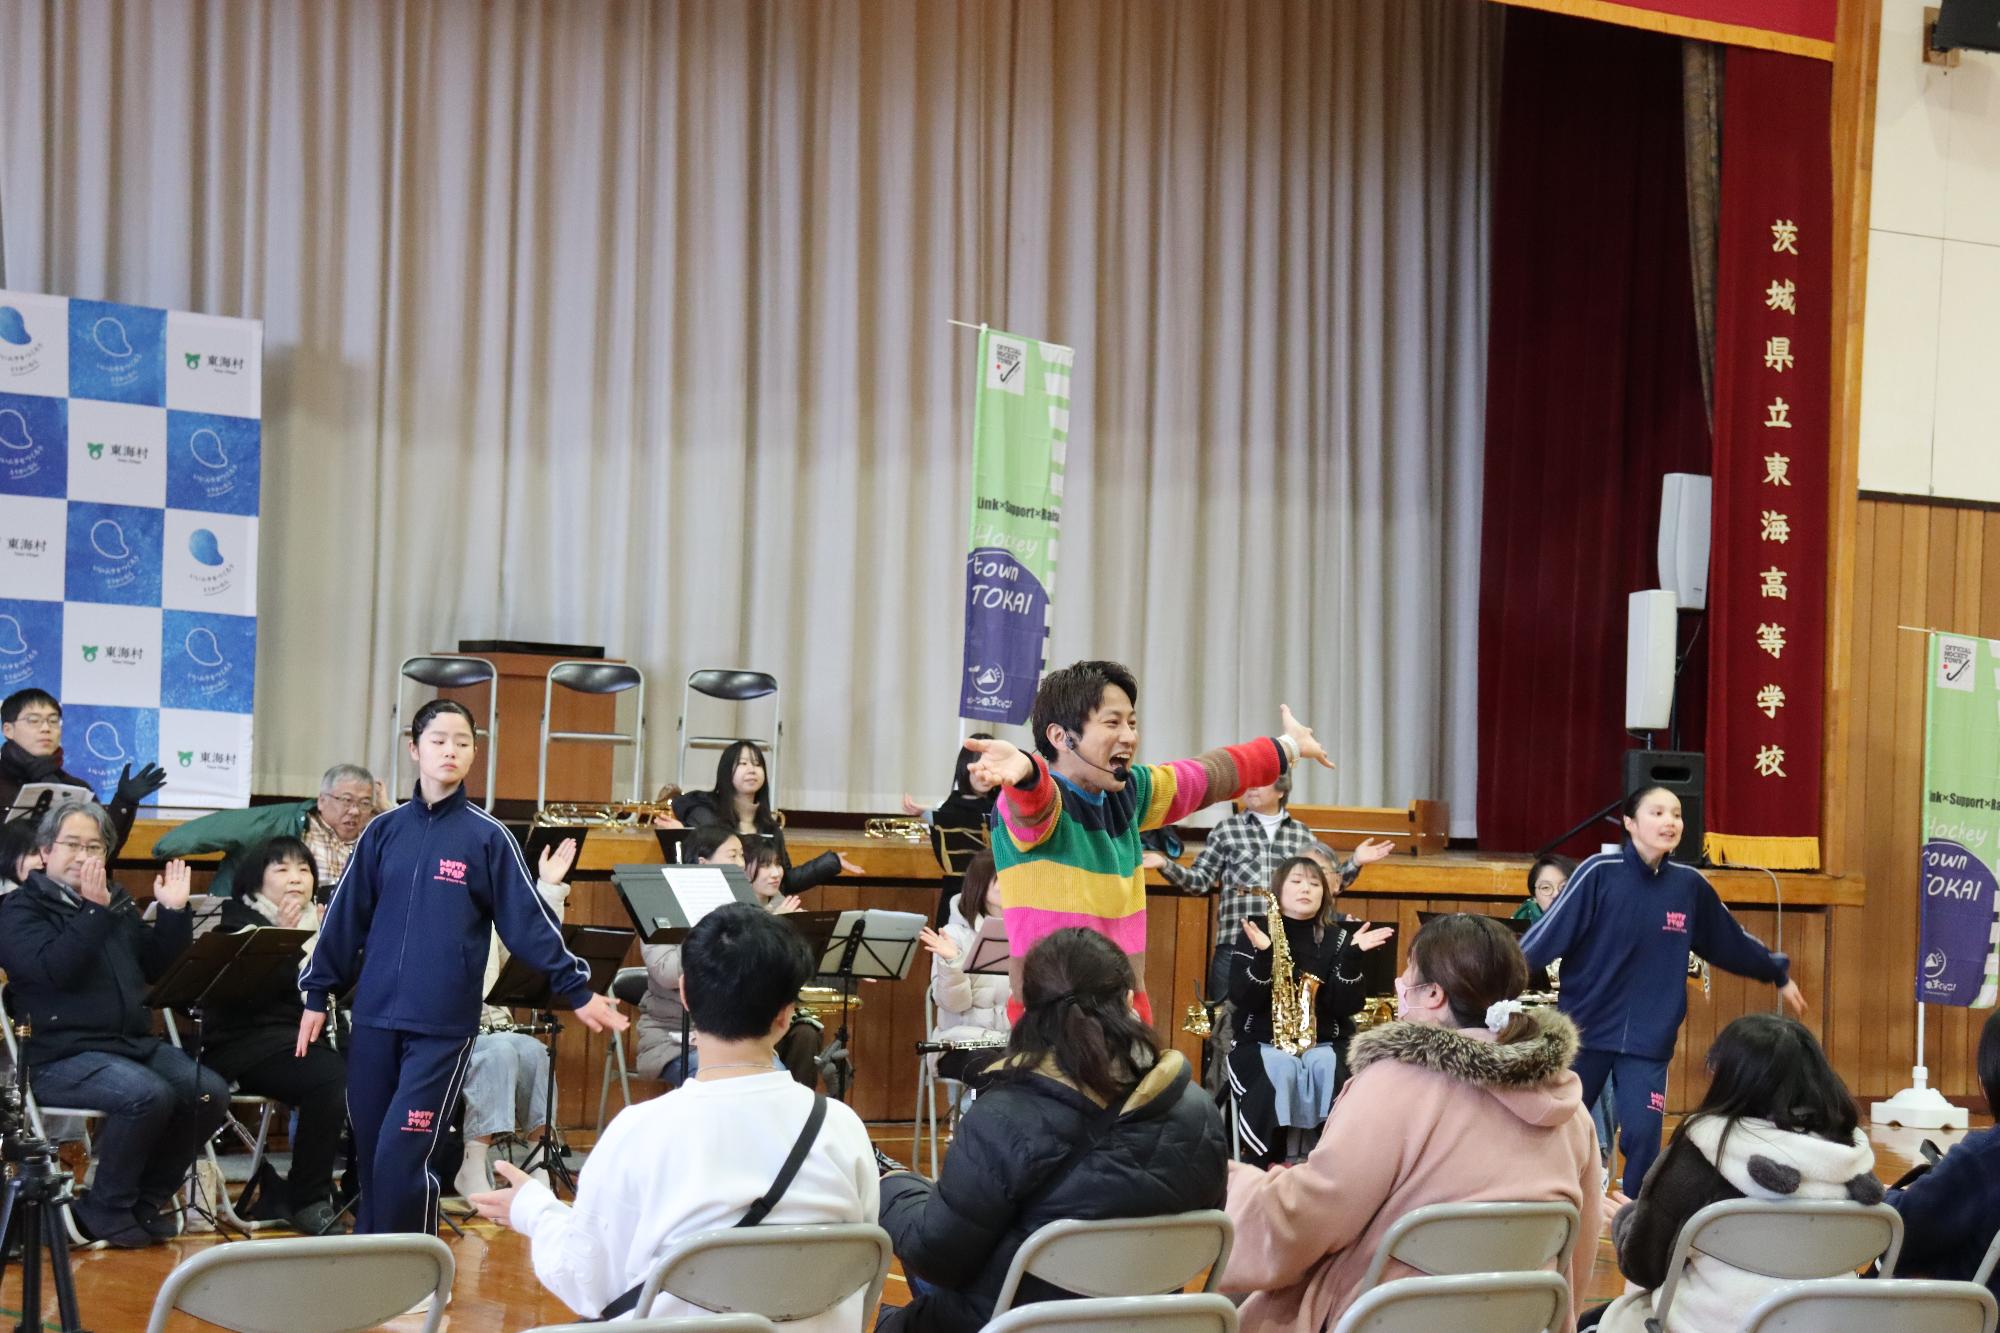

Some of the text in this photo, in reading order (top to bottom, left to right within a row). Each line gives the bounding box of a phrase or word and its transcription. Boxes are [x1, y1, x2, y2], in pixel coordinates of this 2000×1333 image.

[207, 354, 244, 370] 東海村
[111, 443, 149, 460] 東海村
[1754, 219, 1799, 778] 茨城県立東海高等学校
[8, 537, 48, 552] 東海村
[974, 556, 1019, 581] town
[972, 584, 1033, 615] TOKAI
[105, 646, 143, 660] 東海村
[200, 751, 237, 766] 東海村
[1927, 851, 1968, 870] own
[1926, 873, 1982, 901] OKAI
